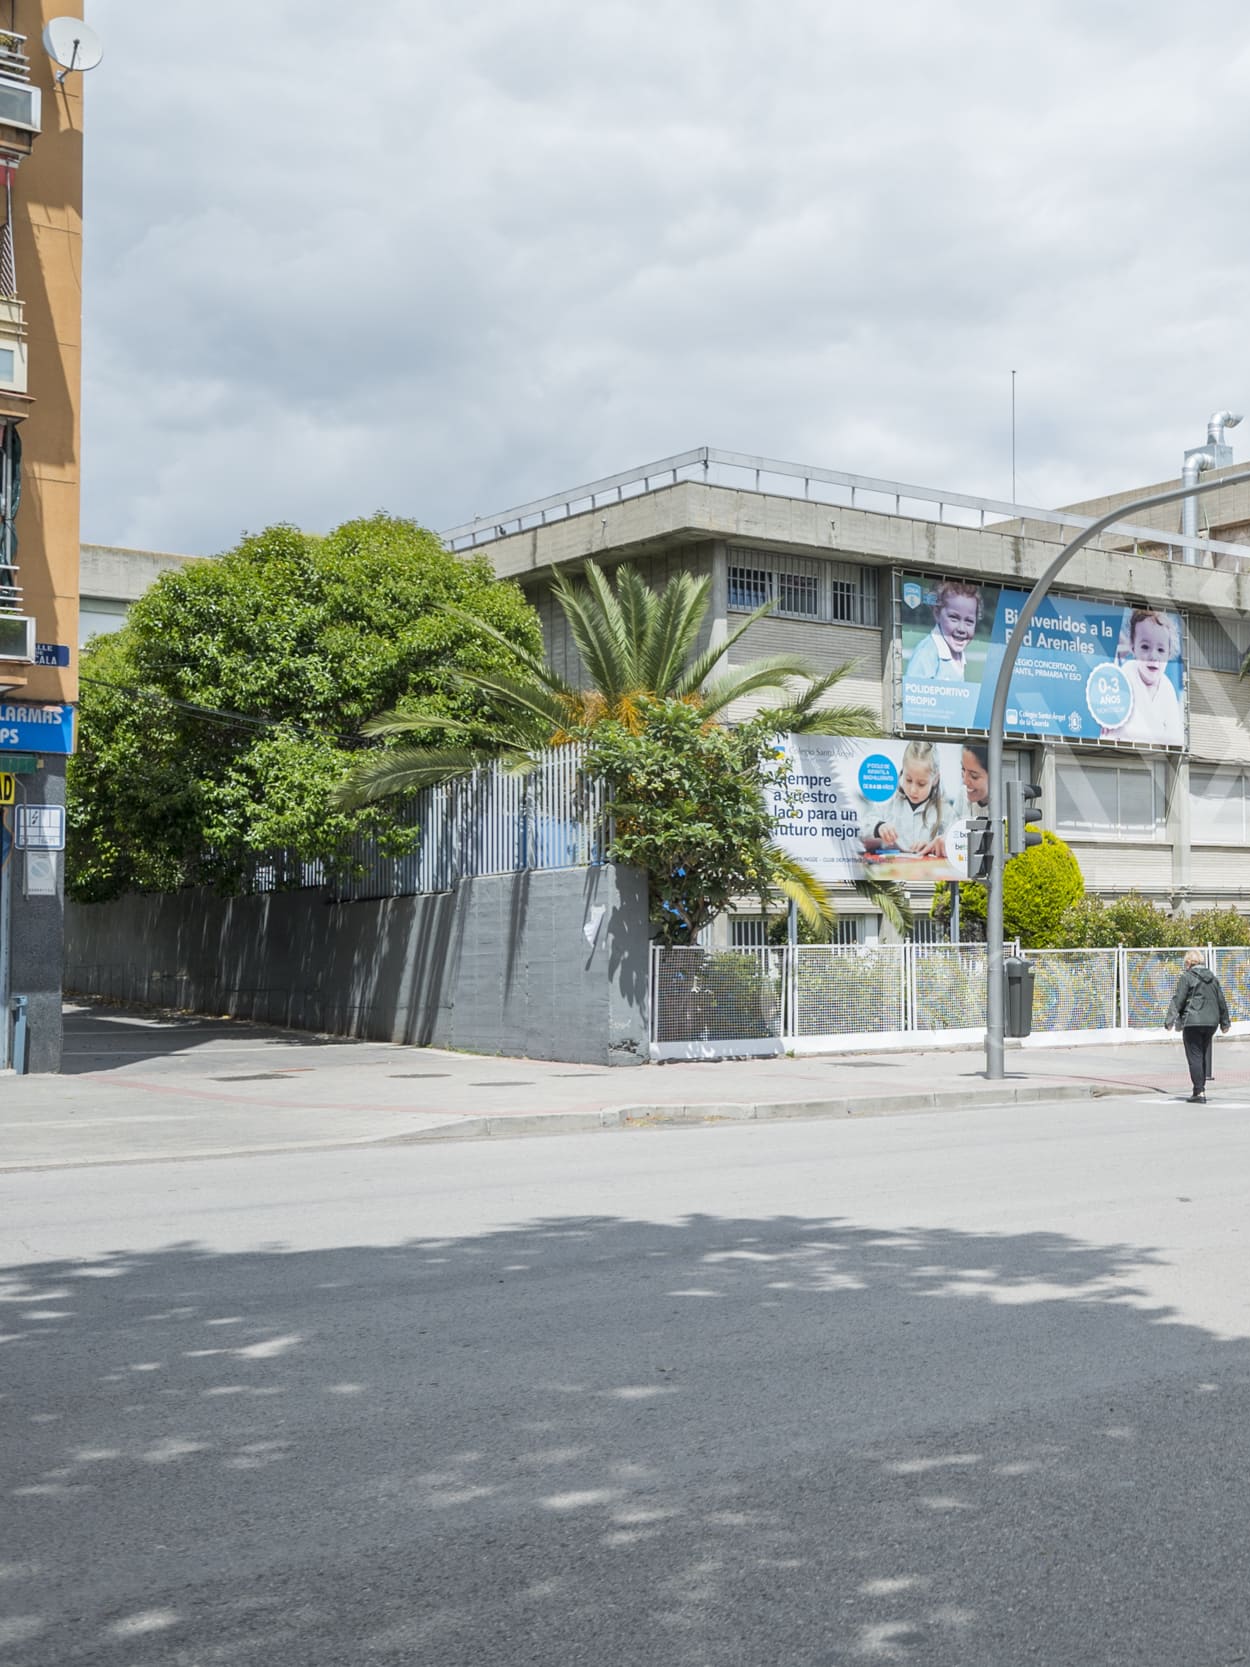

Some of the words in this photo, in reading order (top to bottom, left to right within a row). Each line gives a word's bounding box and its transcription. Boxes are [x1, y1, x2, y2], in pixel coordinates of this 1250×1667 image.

[1004, 608, 1087, 634] Bivenidos
[1090, 624, 1098, 636] a
[1101, 620, 1113, 637] la
[1036, 632, 1095, 655] Arenales
[905, 683, 970, 698] POLIDEPORTIVO
[1098, 677, 1119, 693] 0-3
[905, 695, 937, 706] PROPIO
[1100, 694, 1121, 705] AÑOS
[776, 773, 832, 789] empre
[773, 791, 782, 801] a
[807, 809, 837, 822] para
[840, 811, 858, 821] un
[821, 824, 860, 840] mejor
